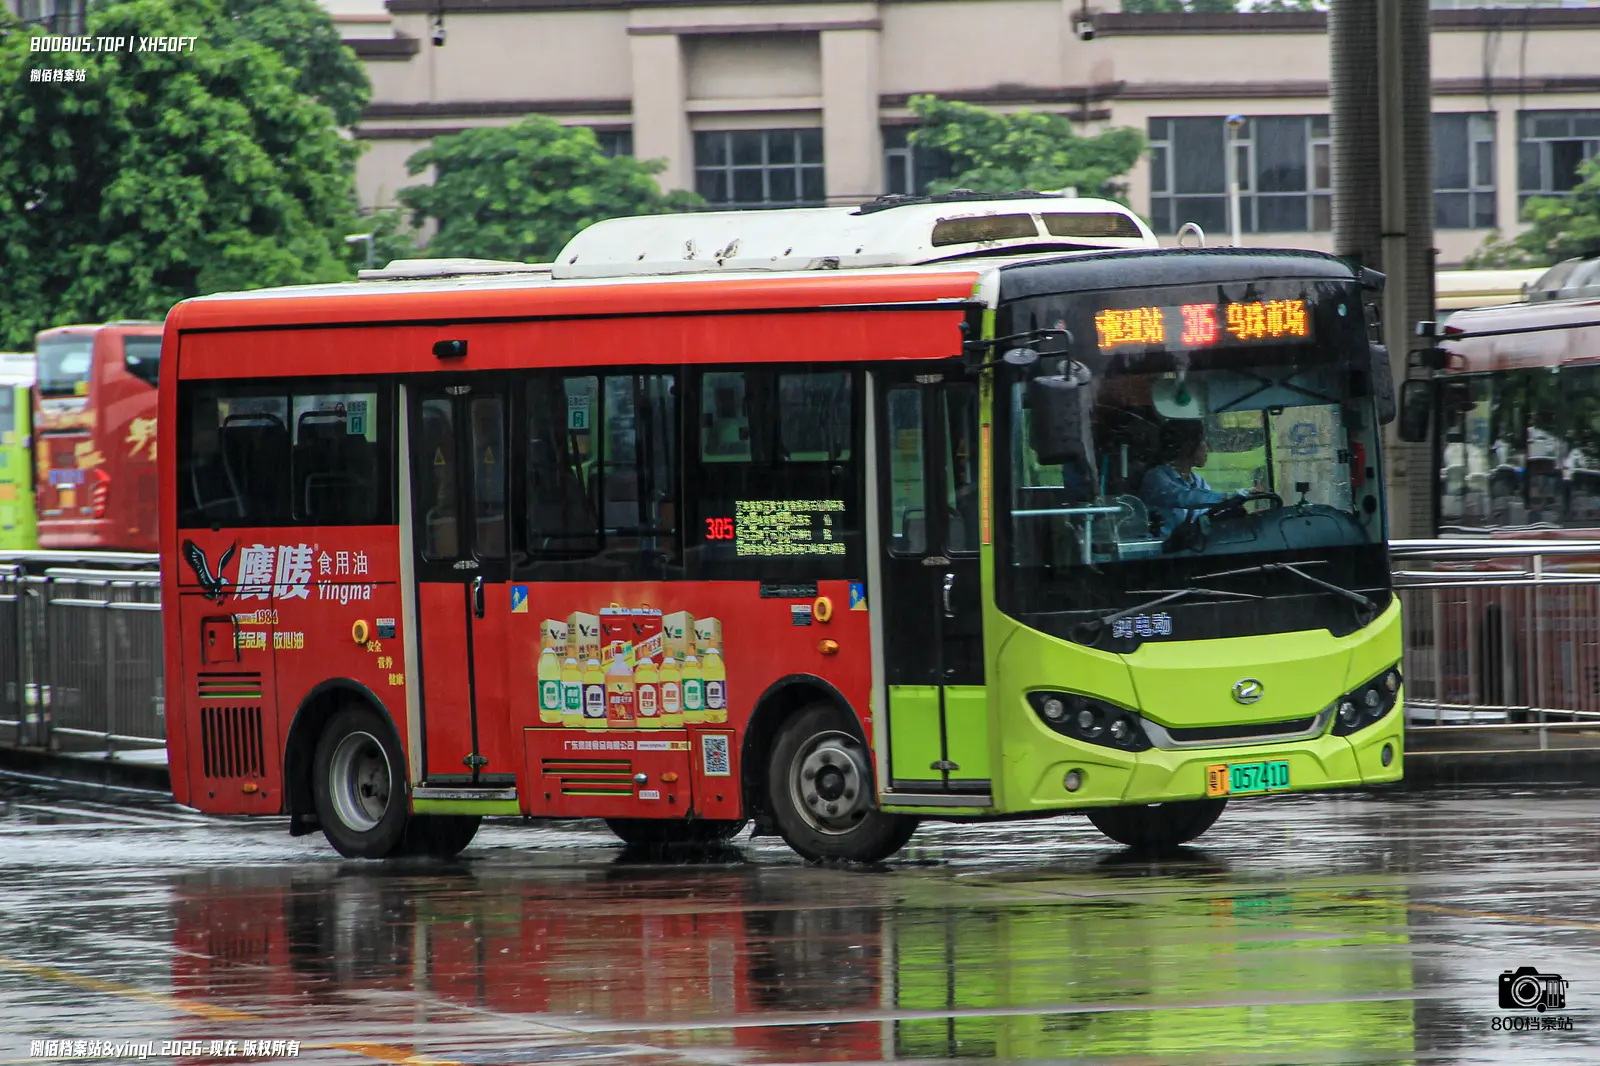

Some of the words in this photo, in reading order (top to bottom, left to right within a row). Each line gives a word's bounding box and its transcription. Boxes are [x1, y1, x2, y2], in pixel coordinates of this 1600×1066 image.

[705, 517, 735, 540] 305
[233, 543, 313, 600] 鹰唛
[317, 550, 368, 575] 食用油
[317, 579, 371, 605] Yingma
[1112, 612, 1172, 638] 纯电动
[273, 631, 304, 650] 放心油
